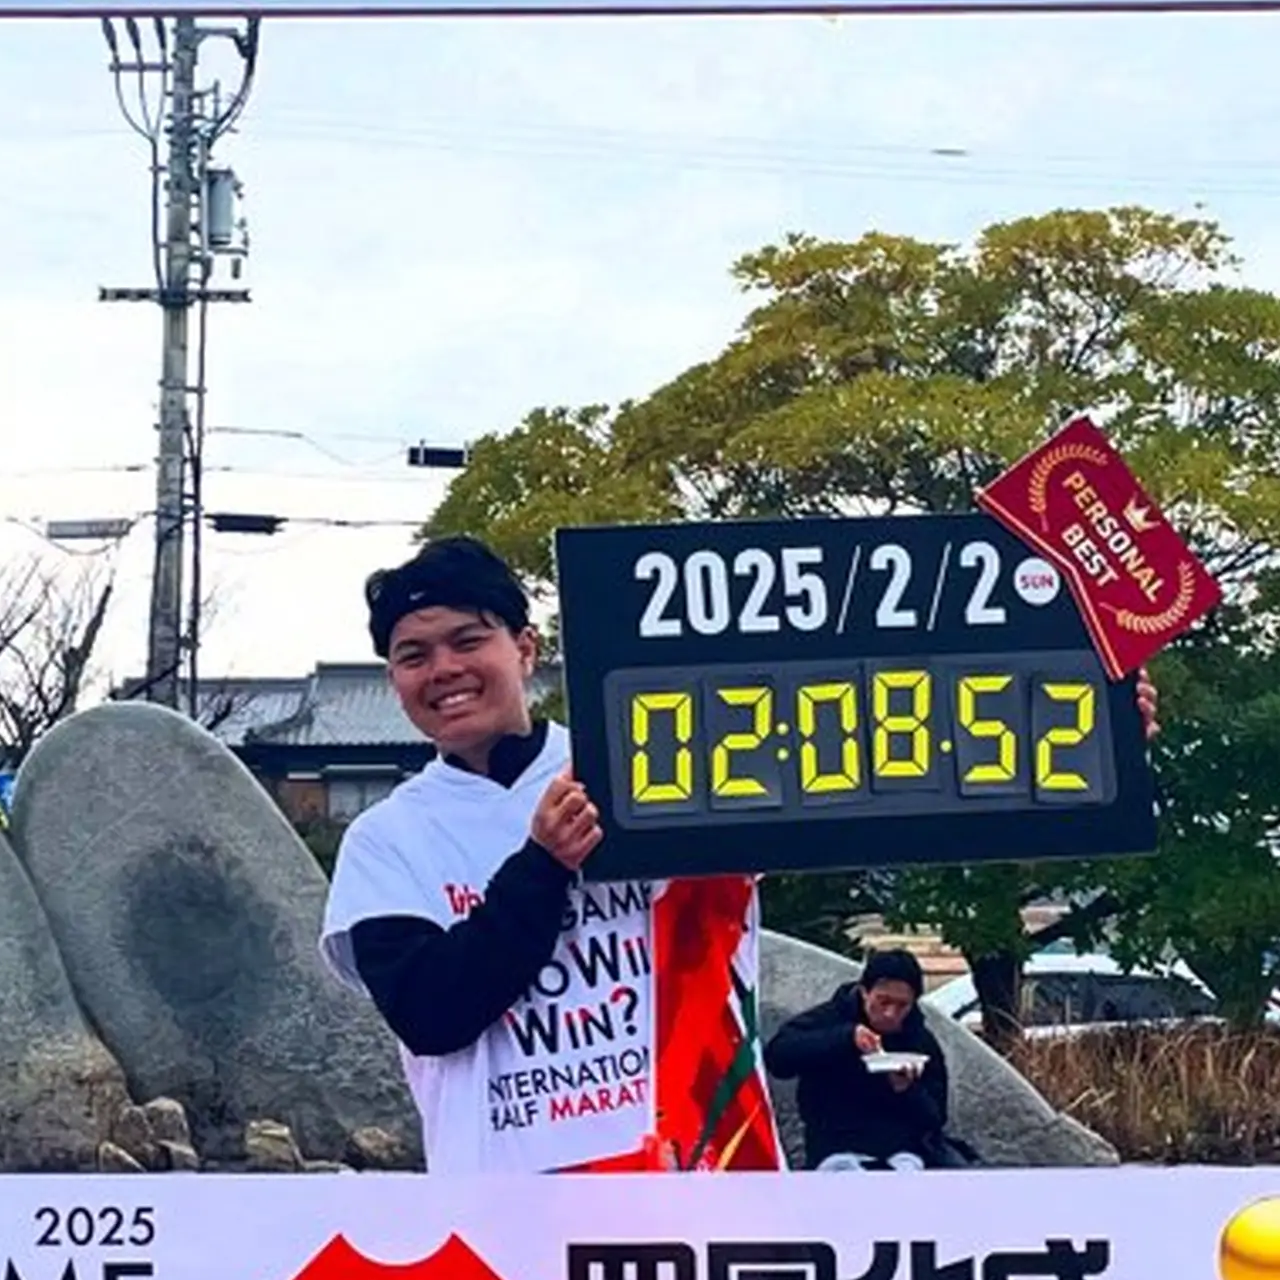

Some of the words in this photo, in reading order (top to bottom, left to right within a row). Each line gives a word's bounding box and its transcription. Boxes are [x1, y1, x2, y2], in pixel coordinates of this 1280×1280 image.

[1060, 522, 1120, 588] BEST
[1061, 470, 1165, 604] PERSONAL
[503, 985, 639, 1057] WIN?
[34, 1206, 156, 1247] 2025
